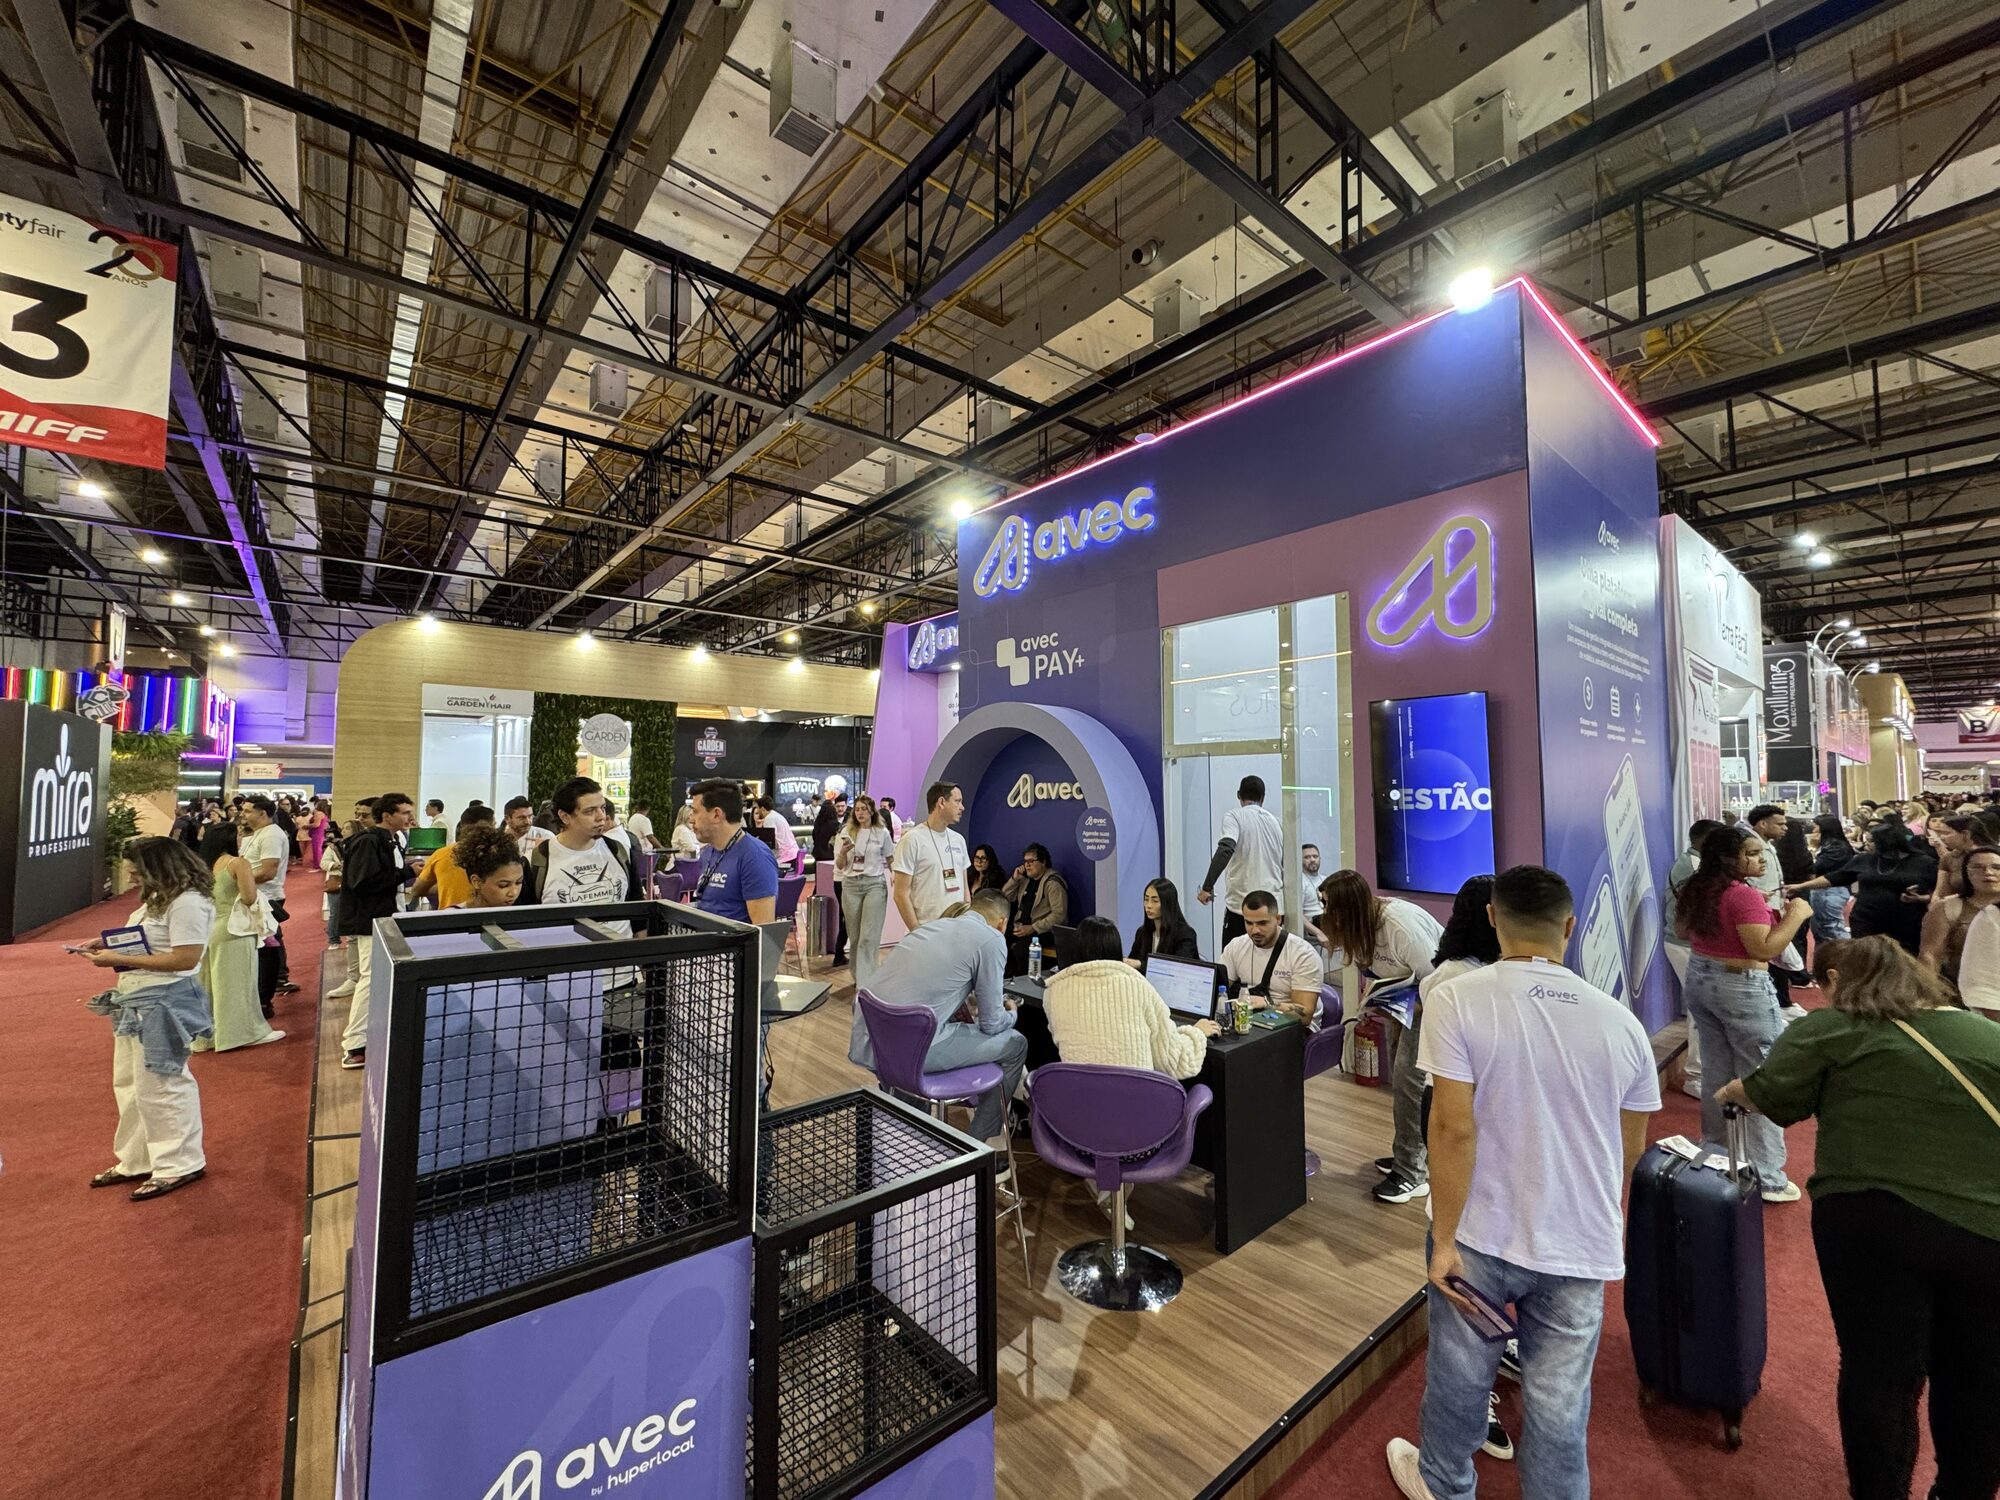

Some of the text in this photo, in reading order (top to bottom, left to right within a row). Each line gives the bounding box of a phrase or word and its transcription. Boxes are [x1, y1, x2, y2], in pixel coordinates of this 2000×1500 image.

[112, 274, 149, 289] ANOS
[1033, 487, 1155, 560] avec
[1607, 608, 1639, 638] completa
[1020, 632, 1059, 652] avec
[1035, 648, 1085, 680] PAY+
[447, 699, 485, 708] GARDEN
[1765, 658, 1796, 743] Maxilluring
[1970, 720, 1988, 733] B
[584, 730, 627, 743] GARDEN
[697, 740, 724, 751] GARDEN
[1922, 770, 1979, 784] Roger
[1034, 782, 1084, 800] avec
[28, 837, 91, 858] PROFESSIONAL
[573, 864, 598, 875] BARBER
[1546, 990, 1579, 1001] avec
[556, 1398, 697, 1489] avec
[591, 1436, 695, 1496] by hyperlocal
